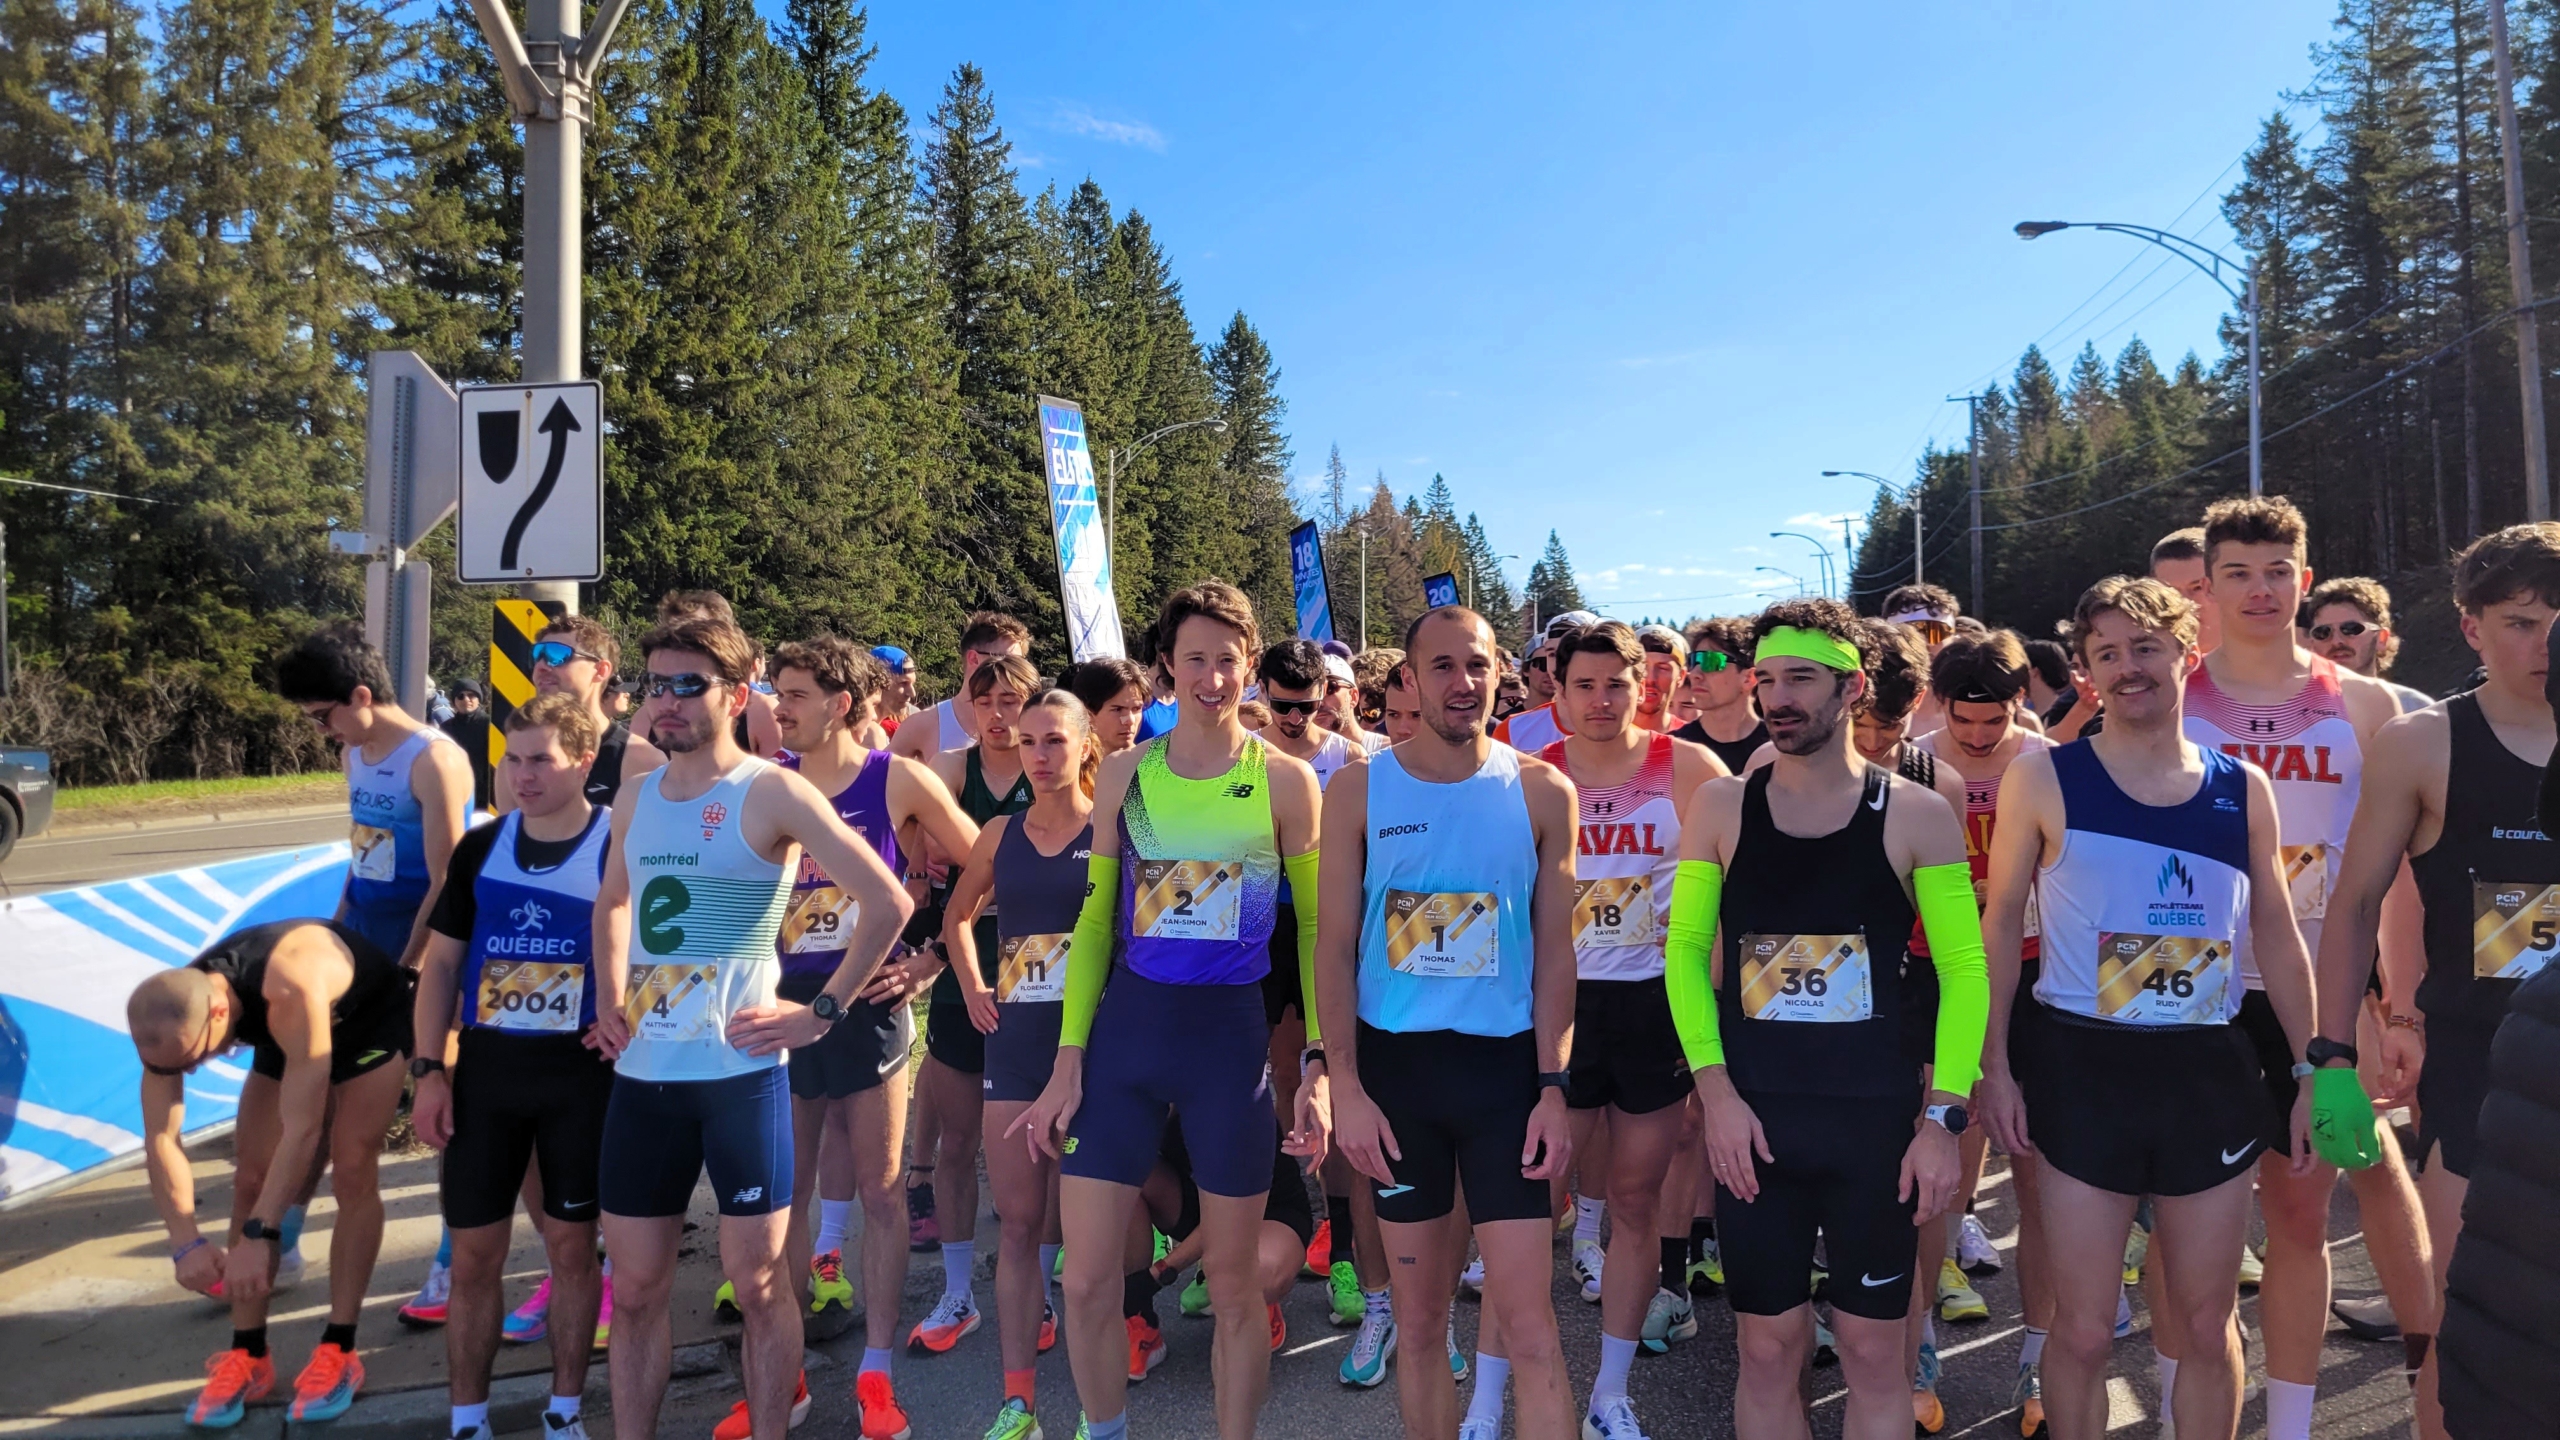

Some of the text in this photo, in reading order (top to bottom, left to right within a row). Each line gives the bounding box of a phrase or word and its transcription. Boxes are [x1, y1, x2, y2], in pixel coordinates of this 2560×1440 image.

[1295, 541, 1315, 570] 18
[1428, 585, 1452, 605] 20
[1379, 822, 1429, 839] BROOKS
[2492, 826, 2505, 839] le
[1577, 823, 1664, 856] AVAL
[639, 852, 699, 867] montréal
[1145, 868, 1160, 876] PCN
[1173, 889, 1194, 916] 2
[1397, 899, 1411, 908] PCN
[2496, 894, 2519, 903] PCN
[805, 911, 840, 934] 29
[1161, 918, 1207, 927] JEAN-SIMON
[1589, 904, 1622, 928] 18
[2147, 910, 2207, 927] QUÉBEC
[810, 934, 837, 942] THOMAS
[1430, 925, 1445, 952] 1
[2529, 920, 2560, 952] 5
[486, 934, 576, 956] QUÉBEC
[1755, 944, 1773, 952] PCN
[2116, 942, 2137, 951] PCN
[1419, 955, 1456, 963] THOMAS
[1024, 959, 1046, 982] 11
[1780, 967, 1828, 997] 36
[2142, 967, 2195, 999] 46
[486, 987, 569, 1015] 2004
[652, 993, 670, 1019] 4
[1784, 999, 1824, 1007] NICOLAS
[2155, 999, 2182, 1009] RUDY
[645, 1021, 678, 1029] MATTHEW
